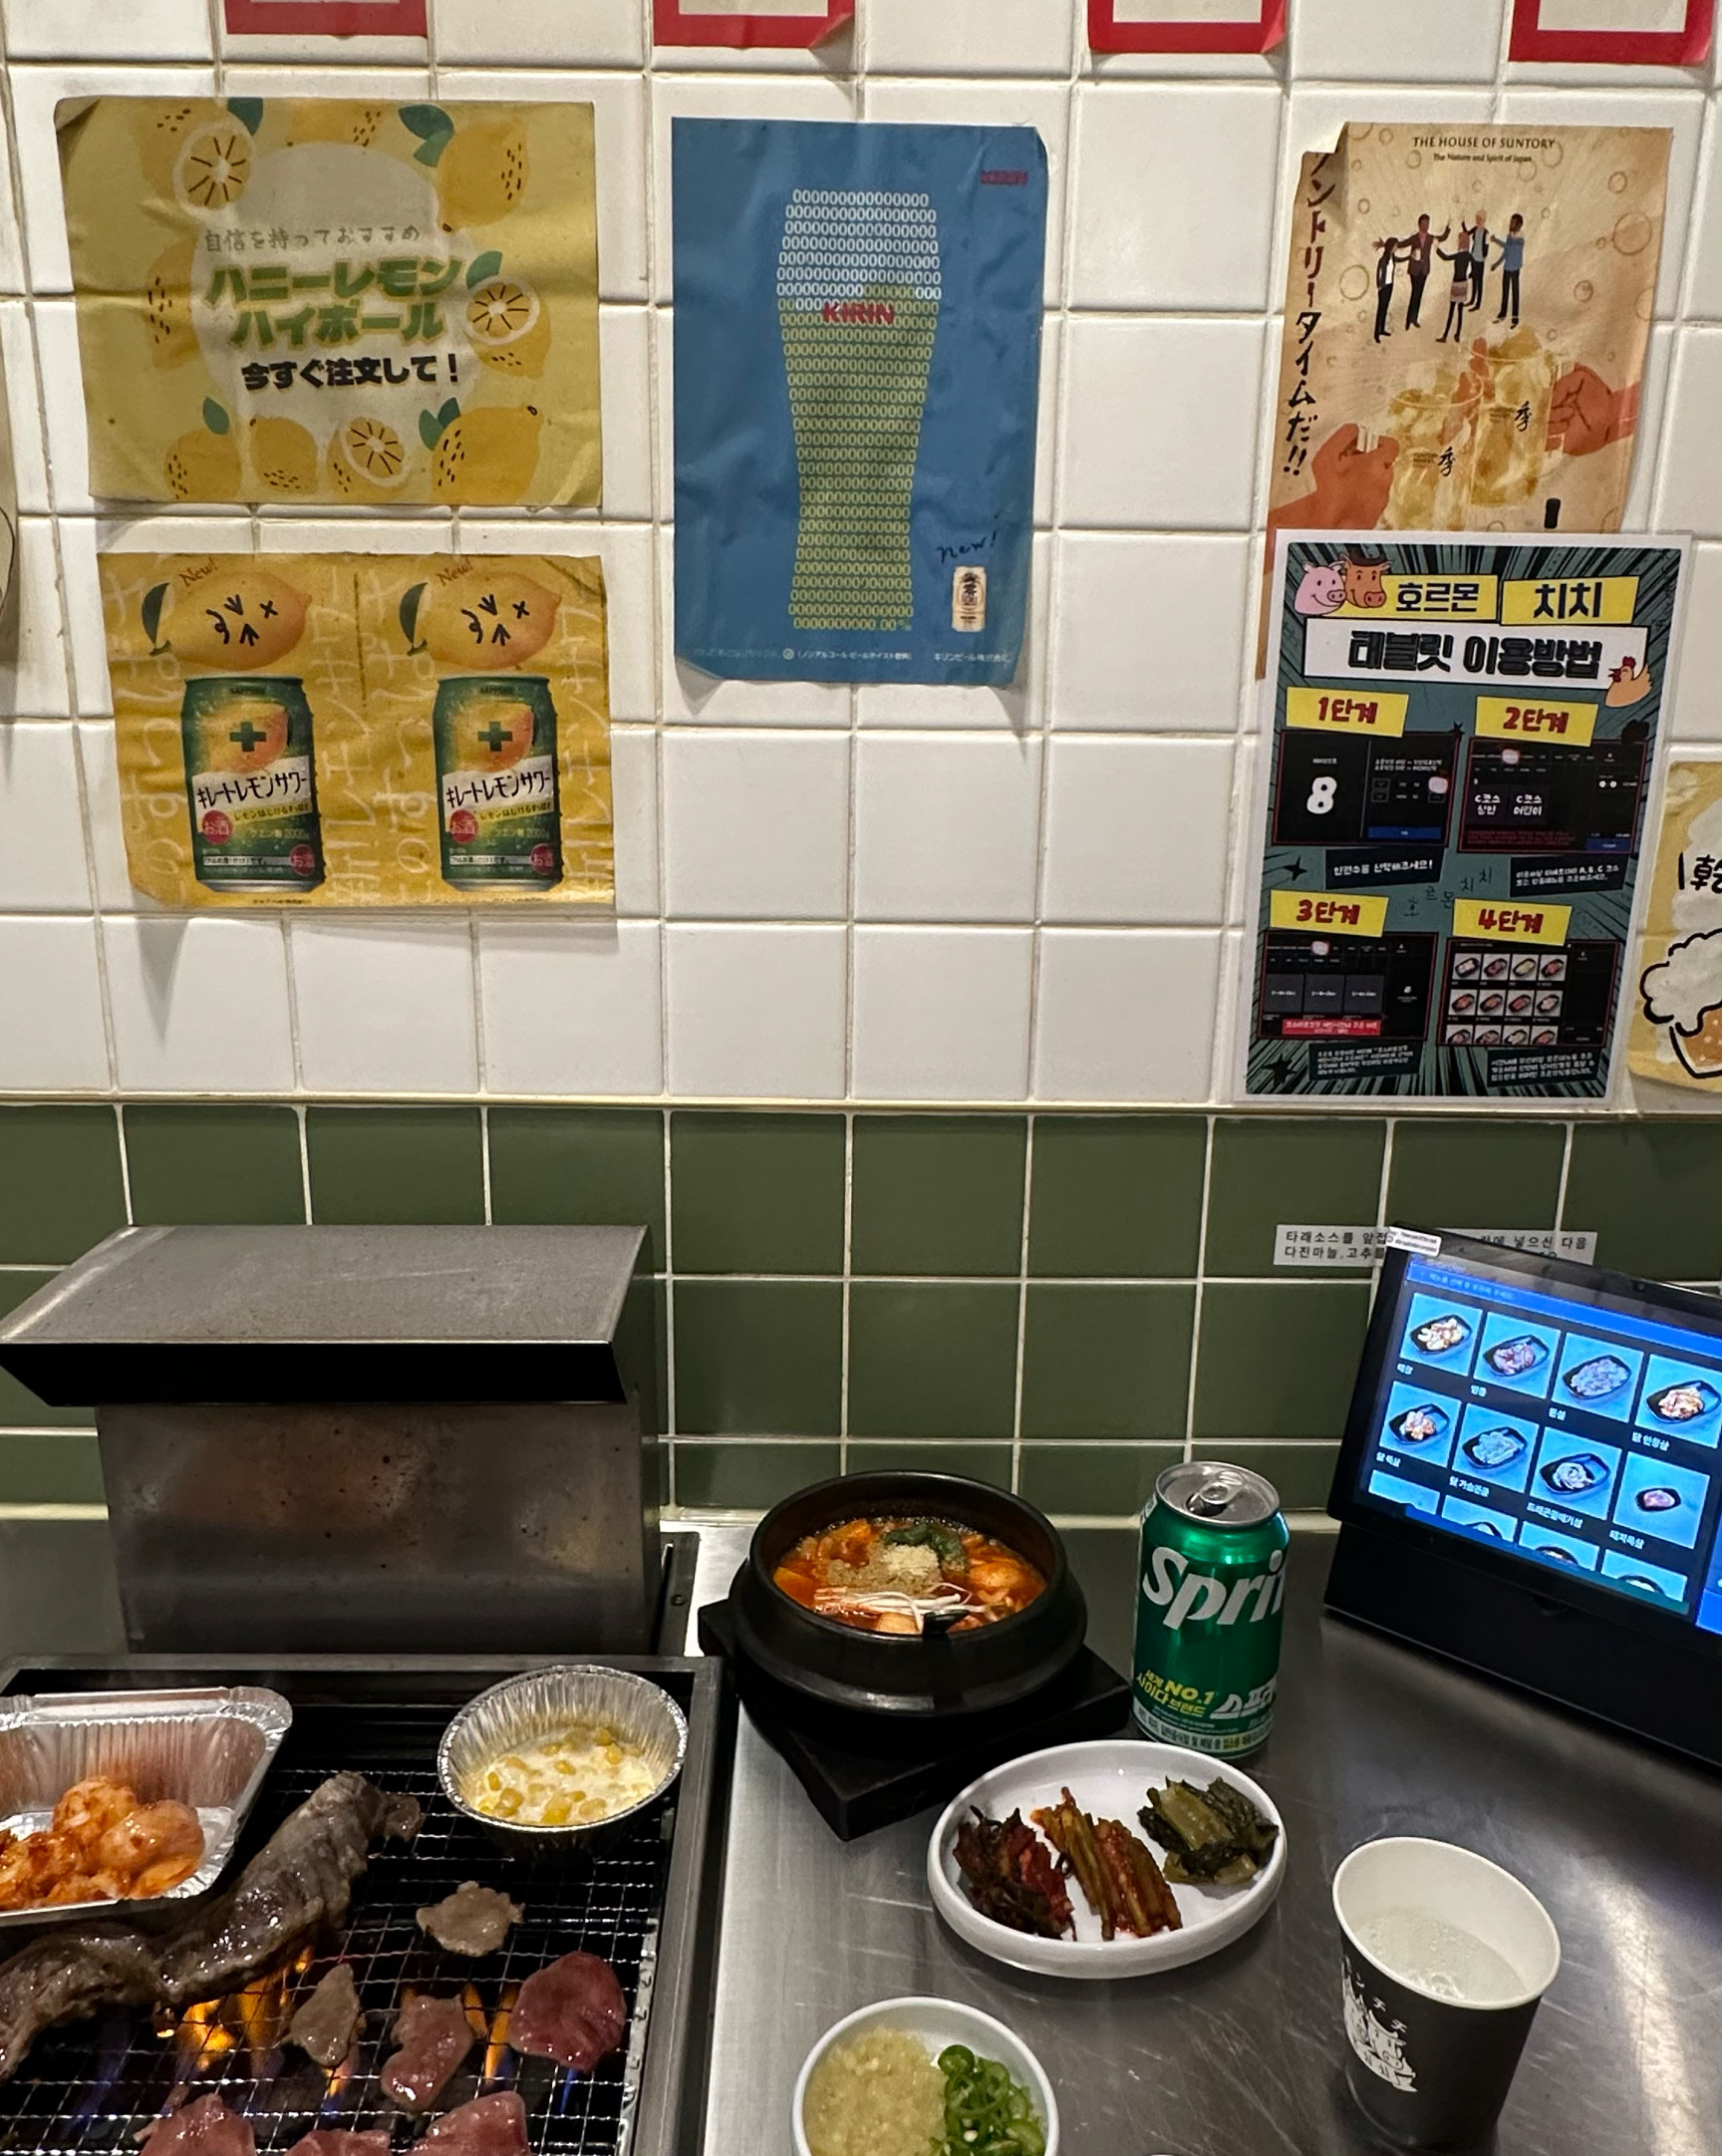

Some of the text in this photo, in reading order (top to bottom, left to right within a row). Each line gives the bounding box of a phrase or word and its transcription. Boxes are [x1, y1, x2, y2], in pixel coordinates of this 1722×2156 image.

[1413, 137, 1556, 149] THE HOUSE OF SUNTORY
[1433, 153, 1445, 161] The
[1472, 154, 1485, 162] and
[1486, 154, 1504, 163] Spirit
[1504, 154, 1513, 162] of
[206, 258, 462, 305] ハニーレモン
[229, 300, 444, 346] ハイボール
[822, 301, 895, 325] KIRIN
[180, 560, 218, 586] New!
[439, 559, 474, 585] New!
[1395, 582, 1601, 619] 호르몬 치치
[1464, 633, 1602, 680] 이용방법
[1317, 697, 1379, 725] 1단계
[1503, 707, 1571, 734] 2단계
[196, 771, 307, 808] キレートレモンサワー
[446, 770, 551, 808] キレートレモンサワー
[1306, 775, 1337, 814] 8
[204, 819, 229, 835] お酒
[451, 818, 475, 834] お酒
[1295, 899, 1360, 926] 3단계
[1478, 909, 1545, 935] 4단계
[1286, 1231, 1353, 1244] 타래소스를
[1562, 1237, 1587, 1250] 다음
[1164, 1680, 1215, 1705] NO.1
